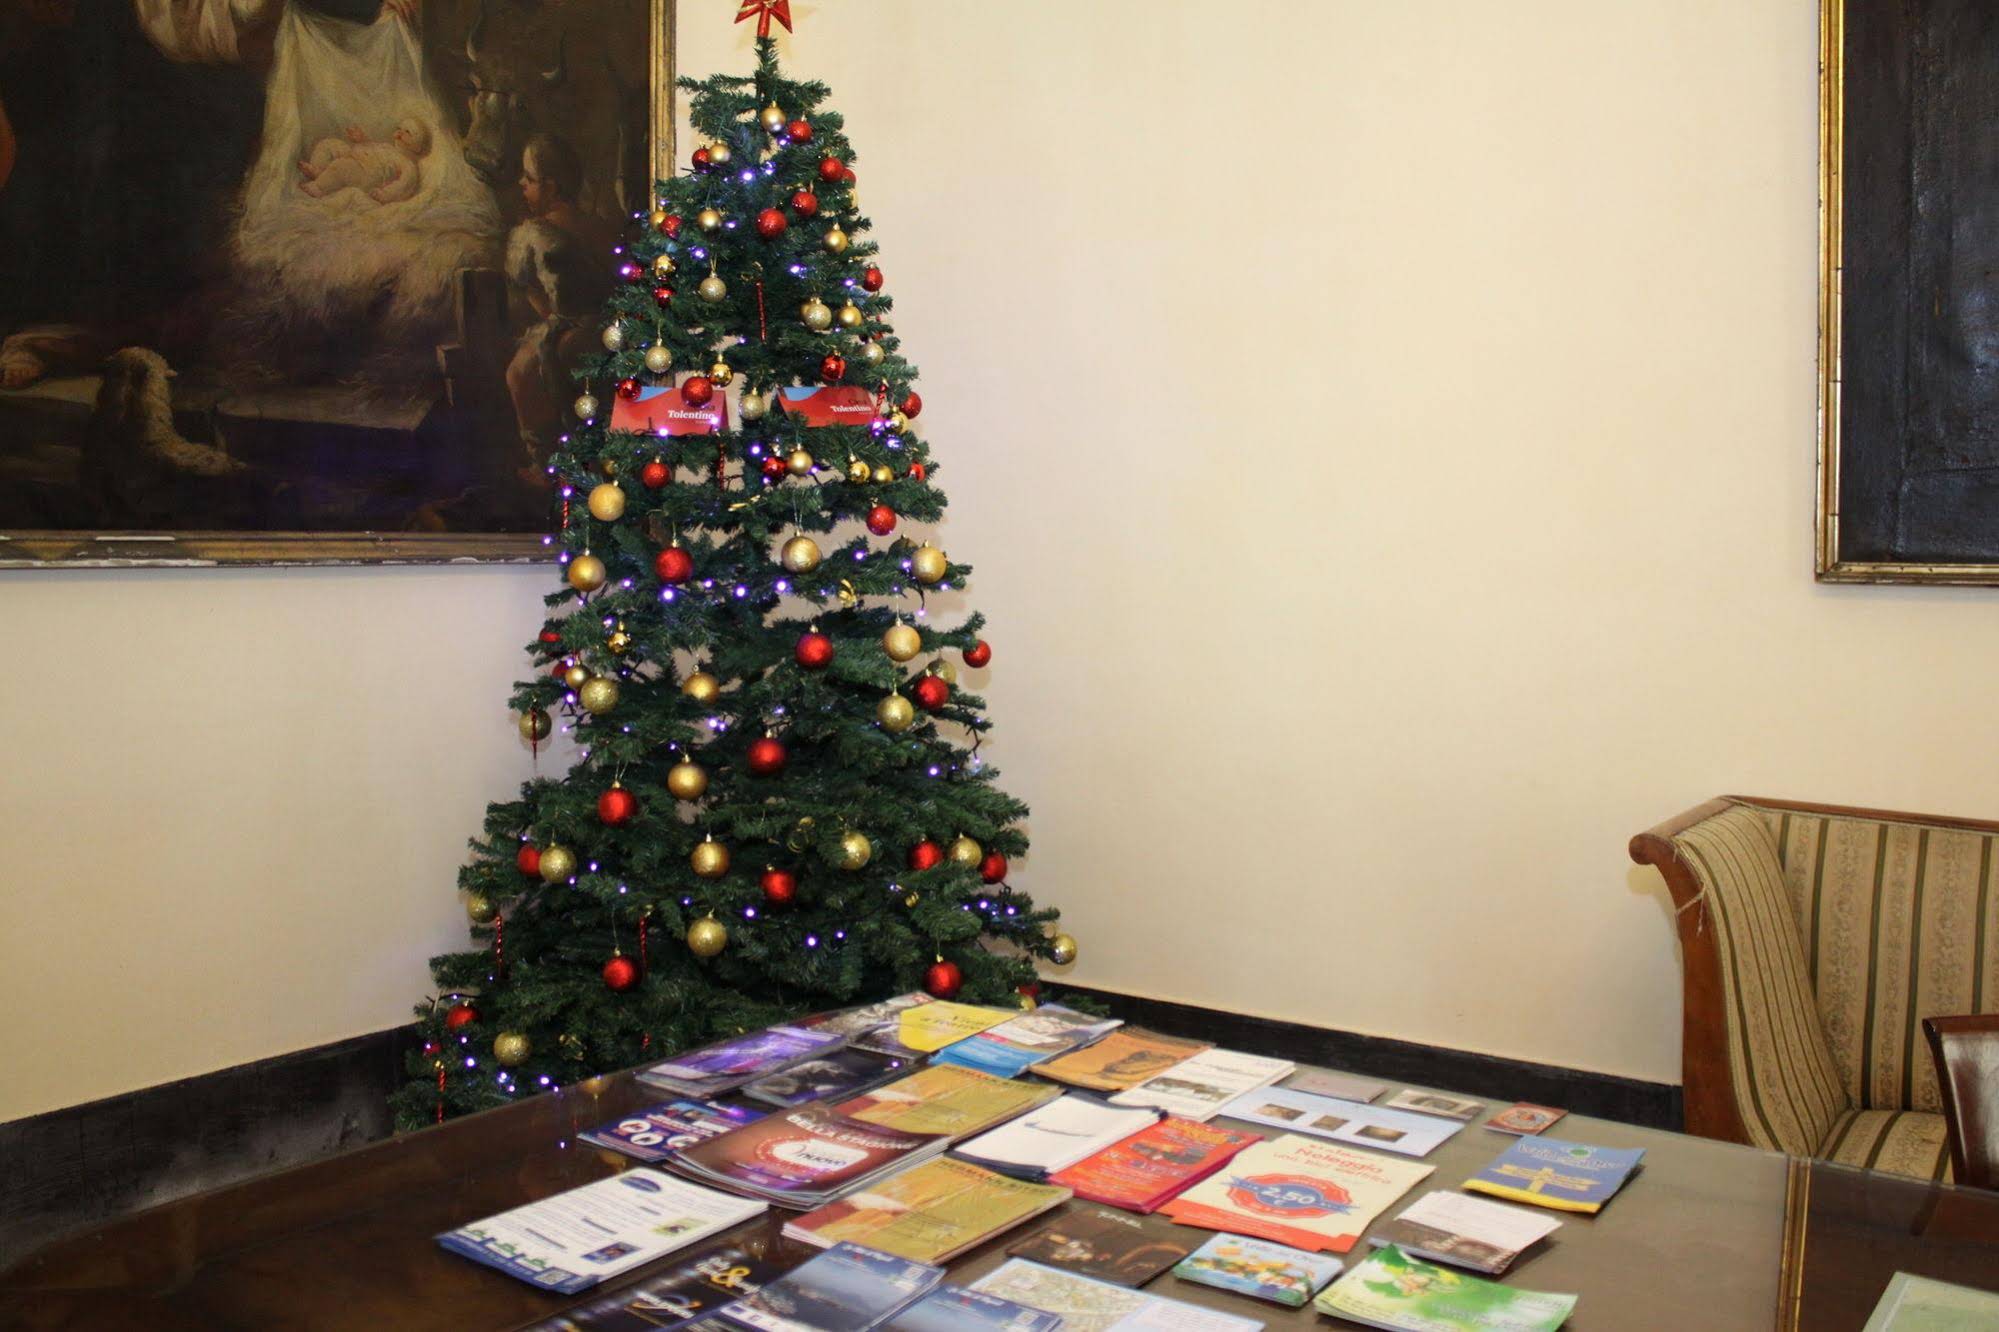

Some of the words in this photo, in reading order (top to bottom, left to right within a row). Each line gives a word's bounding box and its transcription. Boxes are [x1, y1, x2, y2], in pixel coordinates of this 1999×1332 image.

[830, 404, 872, 413] Tolentino
[668, 409, 715, 420] Tolentino
[1295, 1147, 1384, 1173] Noleggio
